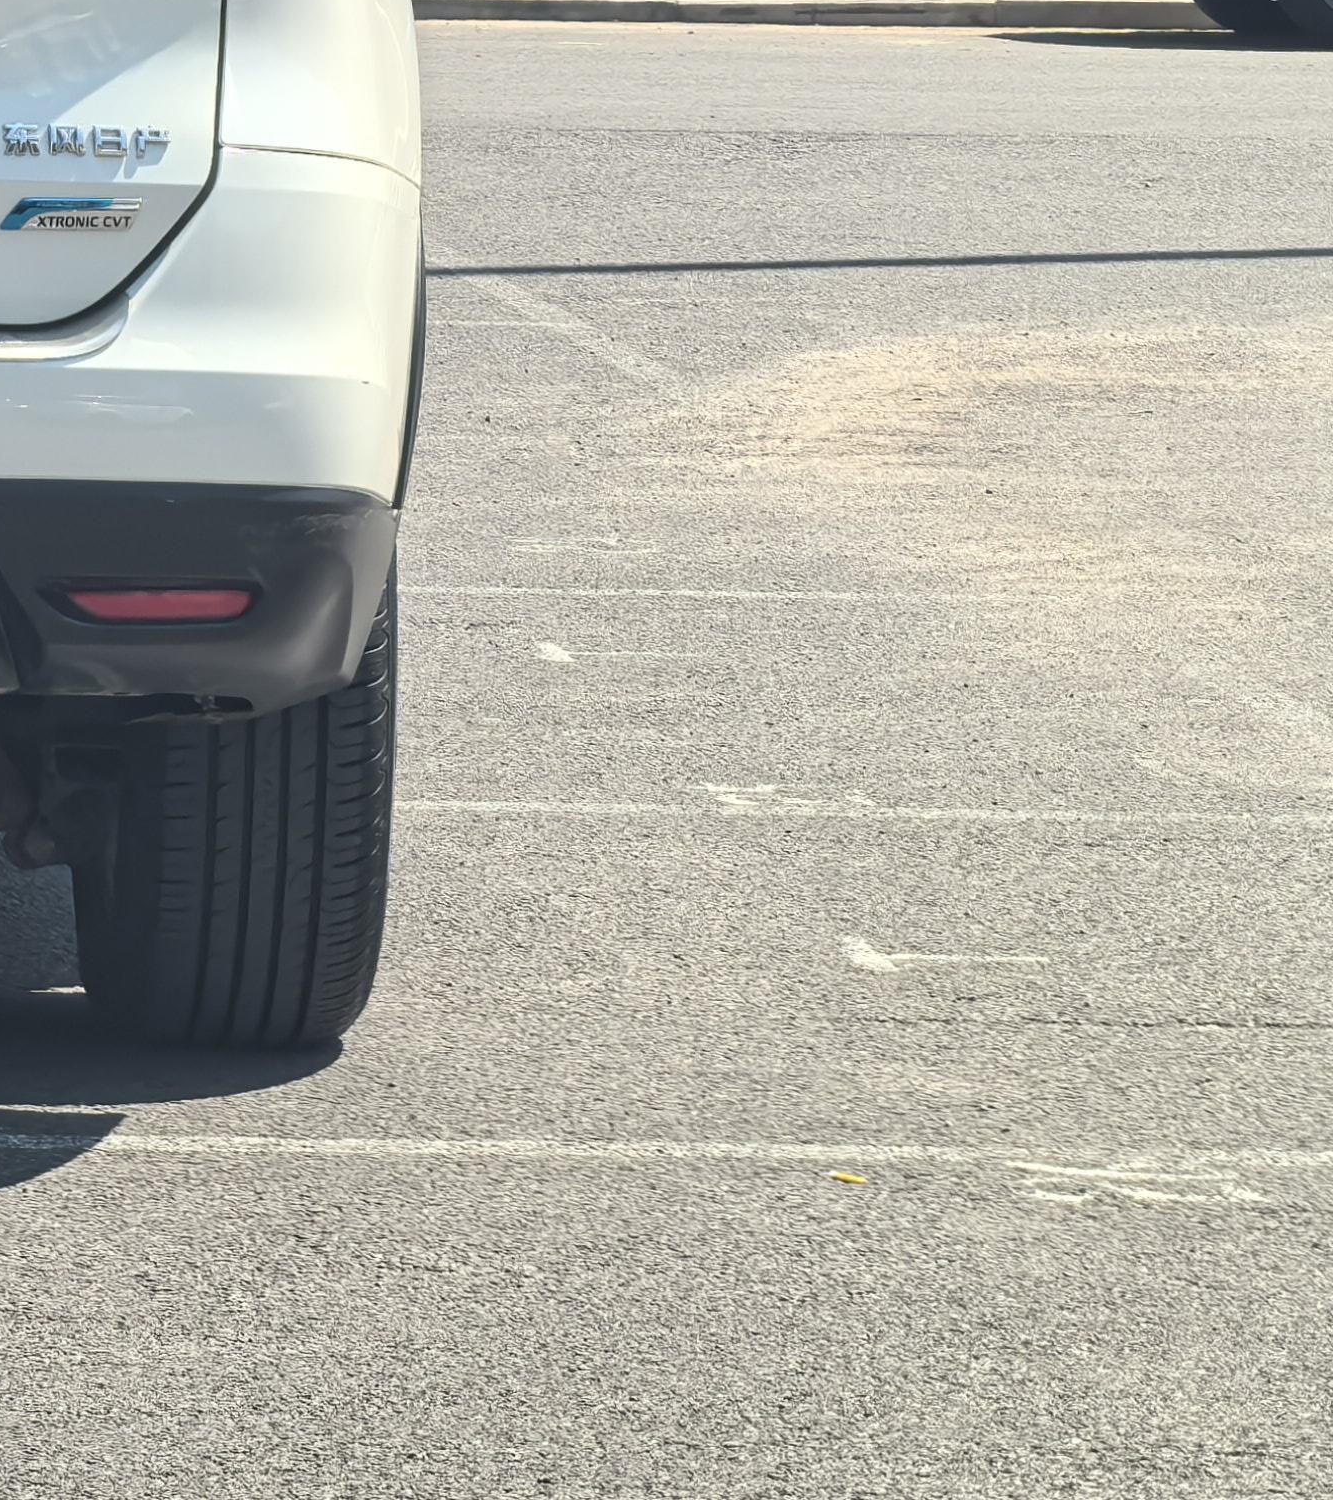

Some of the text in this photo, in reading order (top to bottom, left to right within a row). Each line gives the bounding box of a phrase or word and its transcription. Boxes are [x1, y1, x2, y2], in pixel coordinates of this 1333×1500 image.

[2, 122, 172, 158] 东风日产
[36, 215, 132, 228] XTRONIC CVT
